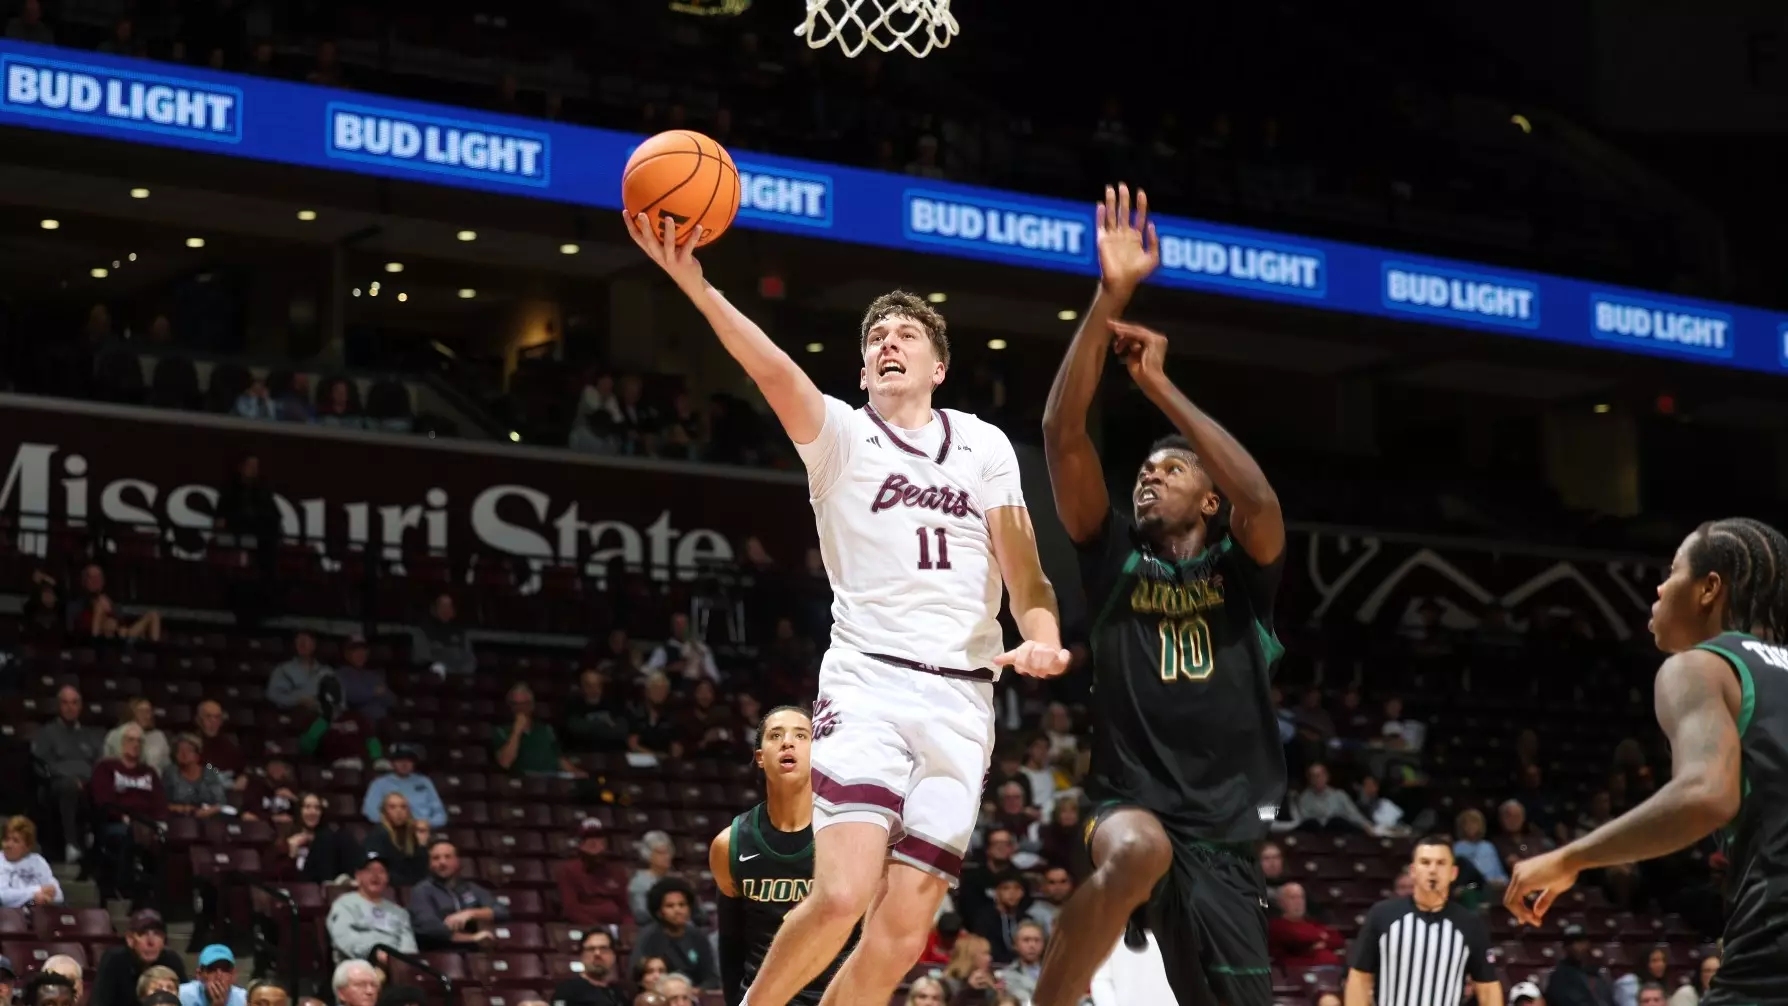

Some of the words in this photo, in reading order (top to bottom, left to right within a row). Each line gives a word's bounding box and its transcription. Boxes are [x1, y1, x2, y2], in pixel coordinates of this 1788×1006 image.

[8, 64, 101, 112] BUD
[106, 79, 233, 131] LIGHT
[334, 113, 422, 158] BUD
[424, 126, 542, 176] LIGHT
[740, 172, 824, 217] IGHT
[911, 198, 984, 239] BUD
[986, 209, 1085, 253] LIGHT
[1160, 235, 1227, 274] BUD
[1229, 245, 1319, 288] LIGHT
[1387, 270, 1449, 307] BUD
[1450, 279, 1533, 319] LIGHT
[1595, 302, 1651, 337] BUD
[1652, 310, 1727, 349] LIGHT
[870, 473, 982, 519] Bears
[471, 484, 734, 594] State
[916, 526, 952, 571] 11
[1159, 618, 1214, 681] 10
[742, 879, 815, 902] LION
